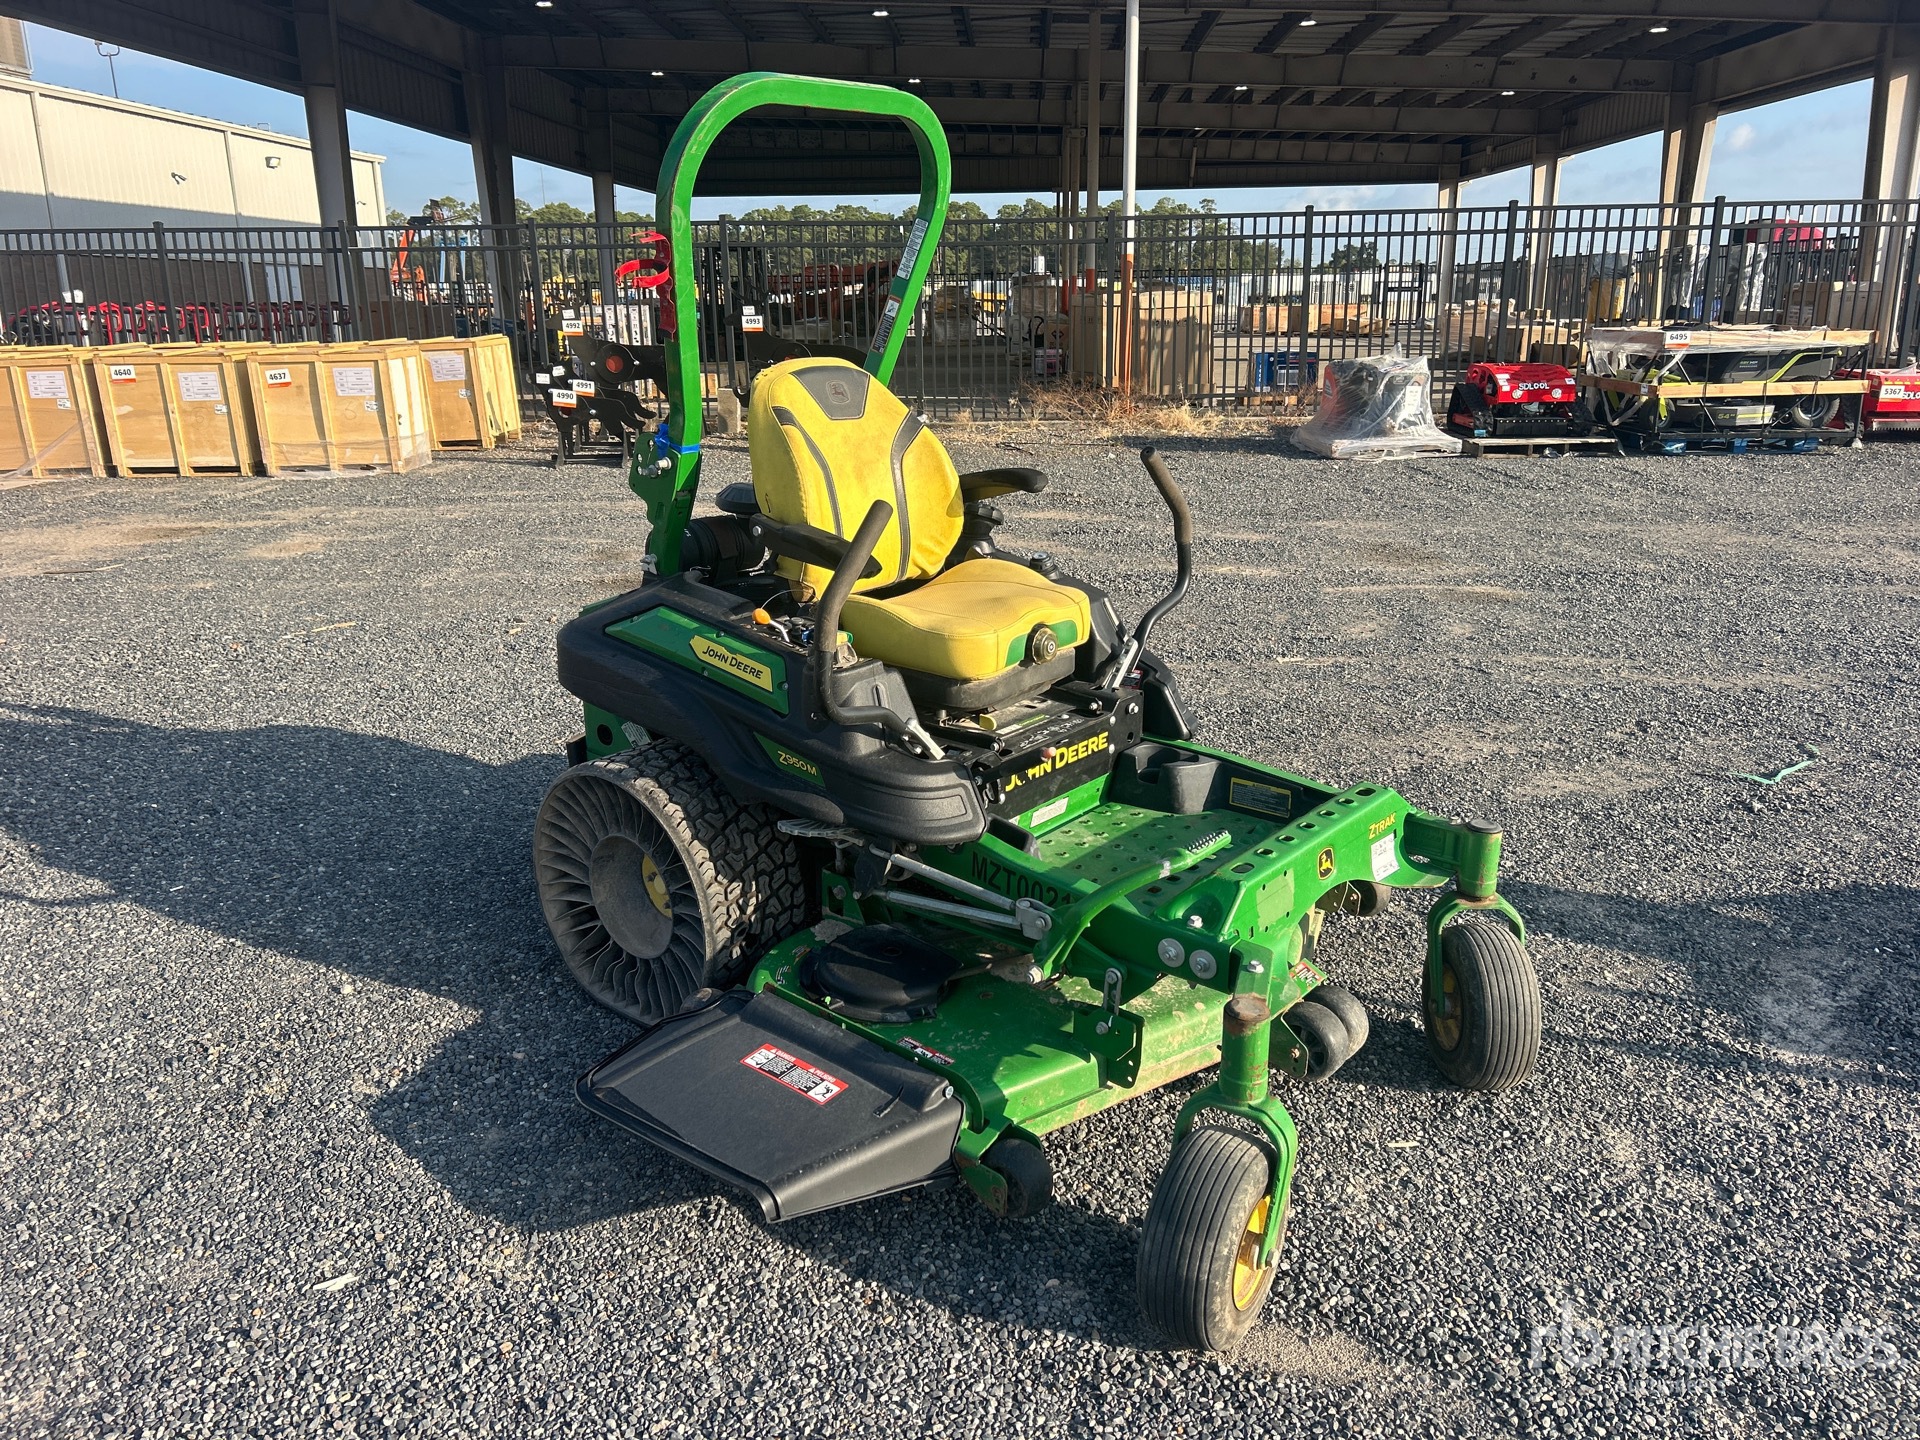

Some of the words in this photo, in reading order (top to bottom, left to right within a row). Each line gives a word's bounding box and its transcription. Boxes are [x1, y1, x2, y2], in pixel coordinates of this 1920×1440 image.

[1669, 333, 1688, 341] 6495
[113, 368, 132, 376] 4640
[268, 372, 287, 380] 4637
[576, 381, 592, 390] 4991
[556, 392, 574, 400] 4990
[702, 645, 729, 666] JOHN
[729, 655, 763, 680] DEERE
[1055, 731, 1109, 769] DEERE
[777, 751, 817, 776] Z950M
[1369, 813, 1396, 840] ZTRAK
